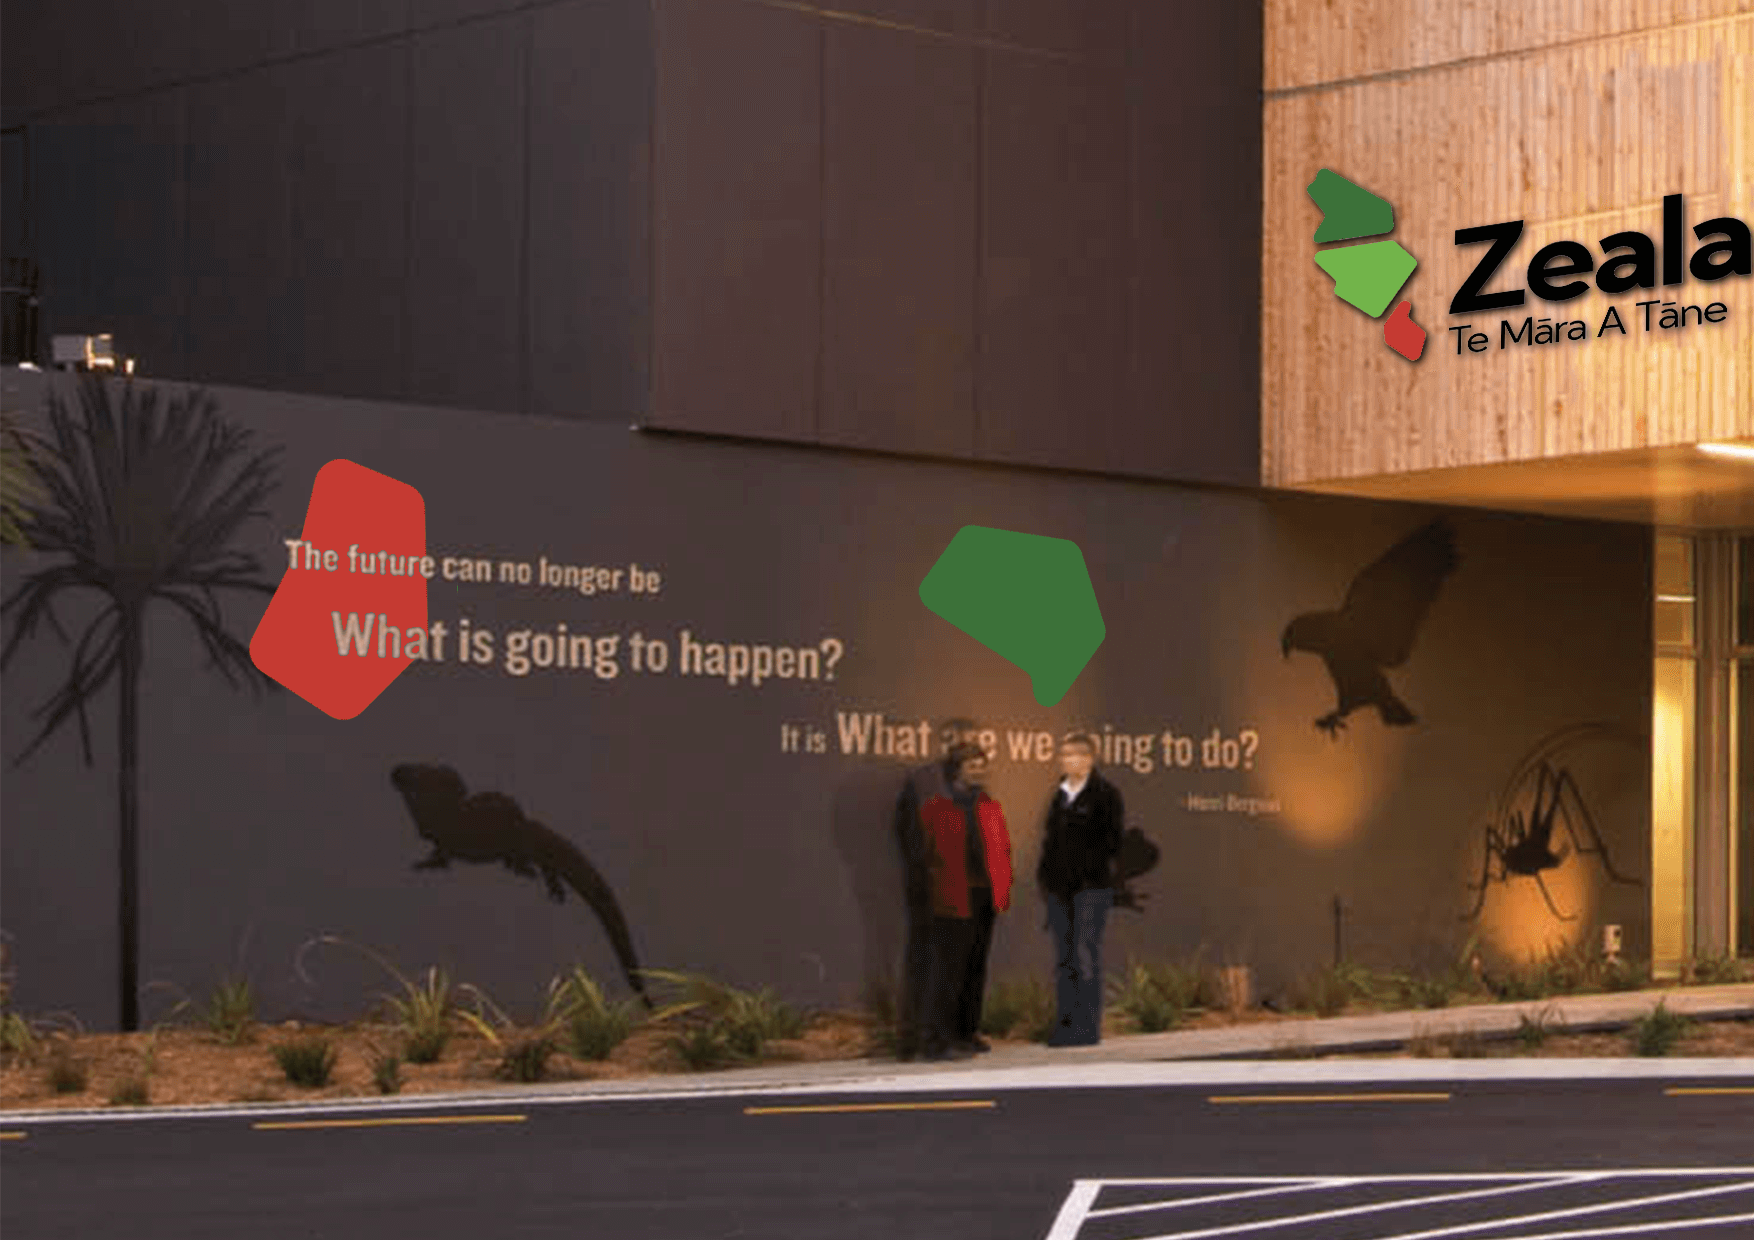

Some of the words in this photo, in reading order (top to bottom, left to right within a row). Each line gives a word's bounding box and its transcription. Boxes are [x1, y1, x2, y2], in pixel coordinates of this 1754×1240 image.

[1449, 324, 1489, 355] Te
[1500, 317, 1587, 350] Māra
[1597, 305, 1627, 338] A
[1635, 299, 1728, 332] Tāne
[284, 539, 338, 572] The
[347, 544, 435, 578] future
[442, 556, 492, 582] can
[500, 559, 532, 584] no
[539, 557, 624, 595] longer
[630, 565, 661, 593] be
[331, 611, 447, 661] What
[459, 619, 495, 664] is
[505, 623, 621, 679] going
[628, 631, 669, 674] to
[679, 630, 843, 686] happen?
[781, 723, 800, 753] It
[805, 725, 827, 753] is
[837, 712, 932, 757] What
[1007, 729, 1053, 762] we
[1162, 730, 1193, 767] to
[1201, 727, 1259, 770] do?
